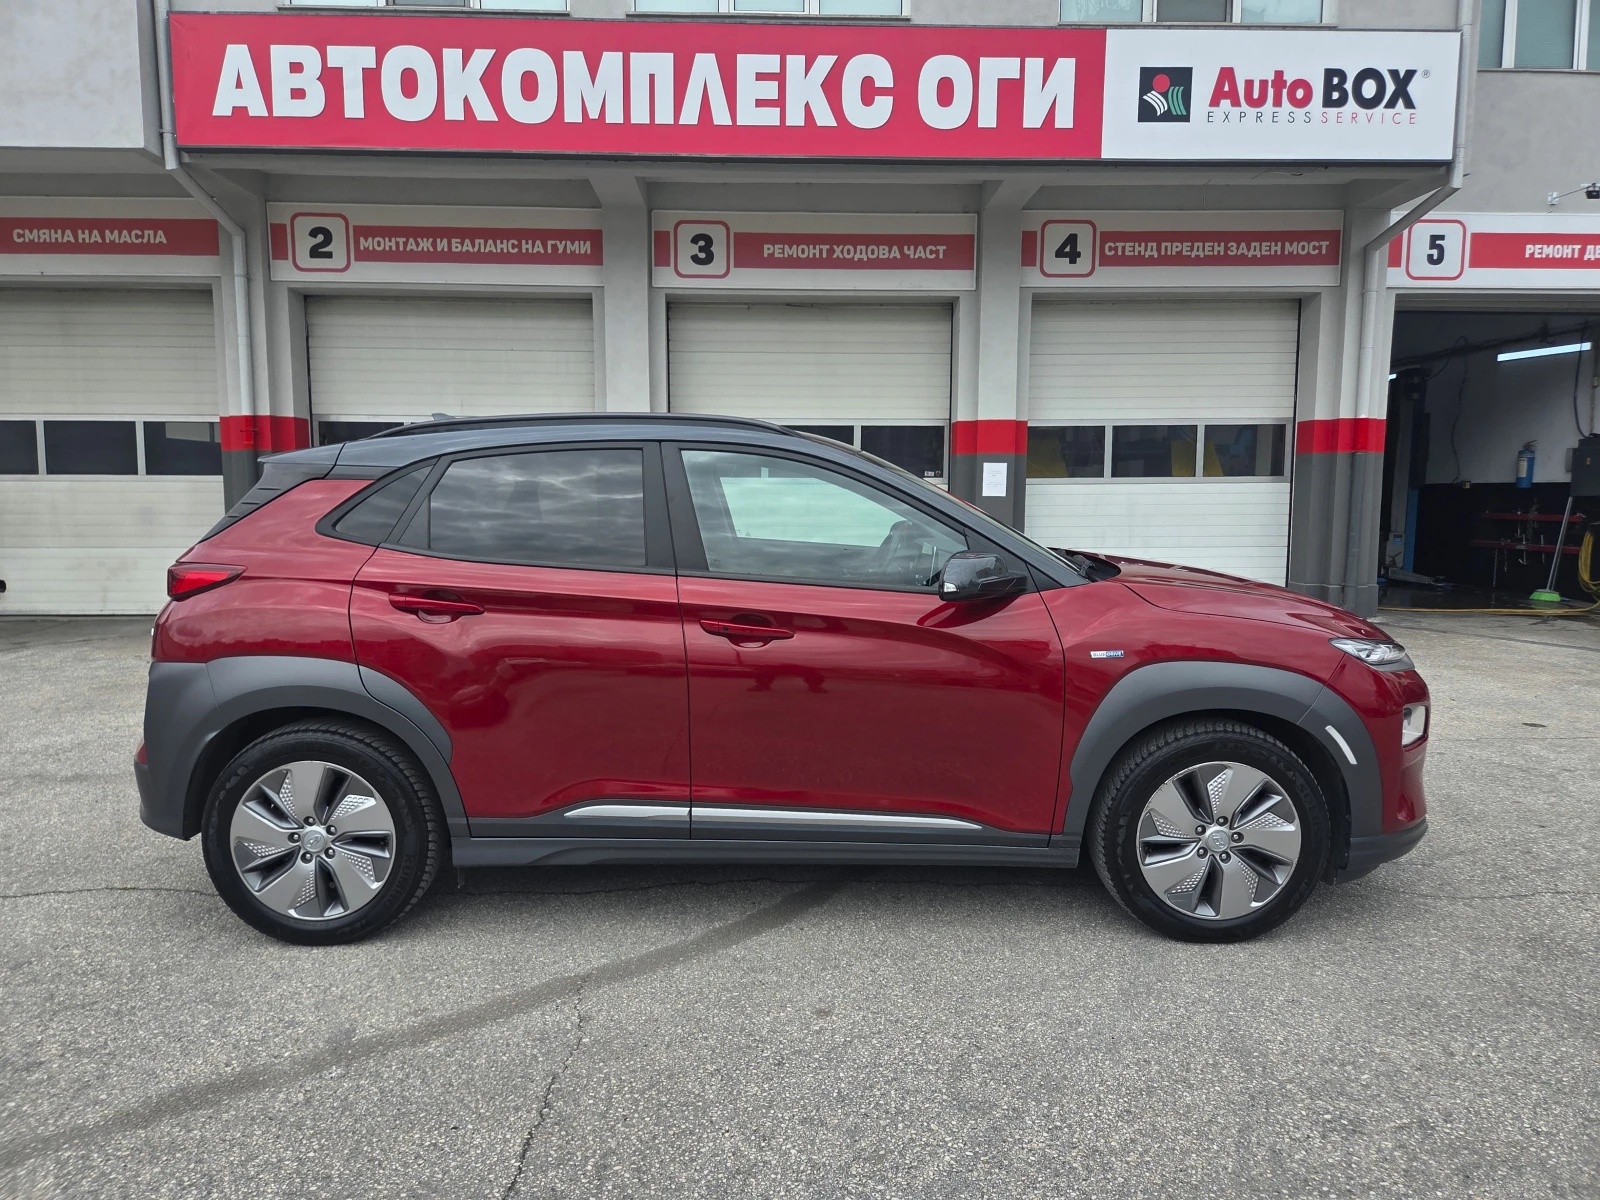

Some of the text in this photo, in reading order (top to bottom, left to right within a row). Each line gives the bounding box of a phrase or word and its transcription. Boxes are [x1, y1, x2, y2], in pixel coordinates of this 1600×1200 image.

[212, 43, 1076, 130] АВТОКОМПЛЕКС ОГИ
[1208, 66, 1314, 109] Auto
[1207, 110, 1418, 125] EXPRESS SERVICE
[12, 229, 168, 245] СМЯНА НА МАСЛА
[308, 226, 334, 259] 2
[359, 236, 592, 255] МОНТАЖ И БАЛАНС НА ГУМИ
[689, 232, 715, 266] 3
[1054, 232, 1082, 265] 4
[1104, 241, 1330, 258] СТЕНД ПРЕДЕН ЗАДЕН МОСТ
[763, 243, 947, 262] РЕМОНТ ХОДОВА ЧАСТ
[1426, 234, 1446, 266] 5
[1524, 244, 1582, 259] РЕМОНТ
